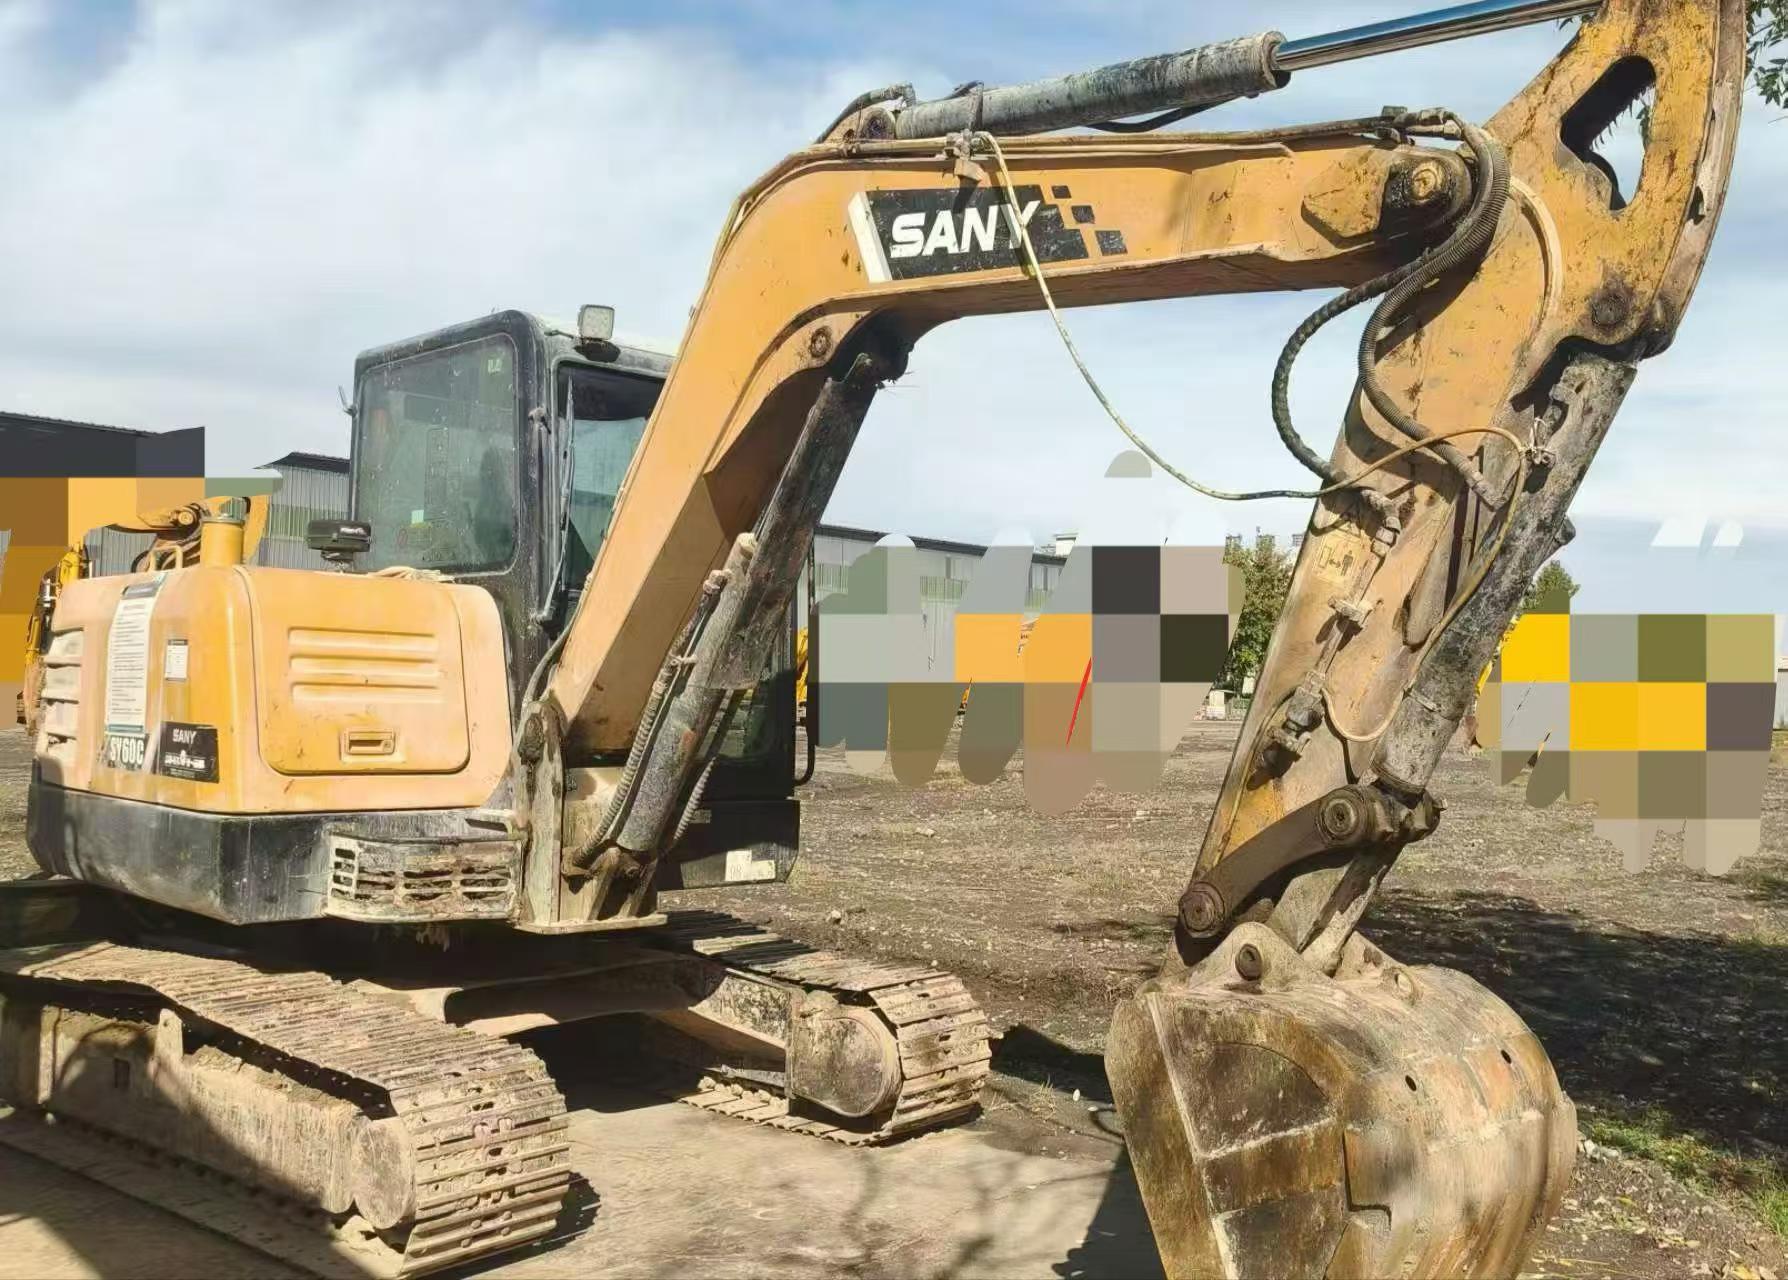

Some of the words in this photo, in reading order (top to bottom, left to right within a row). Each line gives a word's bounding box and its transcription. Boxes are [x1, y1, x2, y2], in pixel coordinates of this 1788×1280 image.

[890, 200, 1041, 259] SANY
[109, 735, 144, 766] SY60C
[172, 728, 197, 745] SANY
